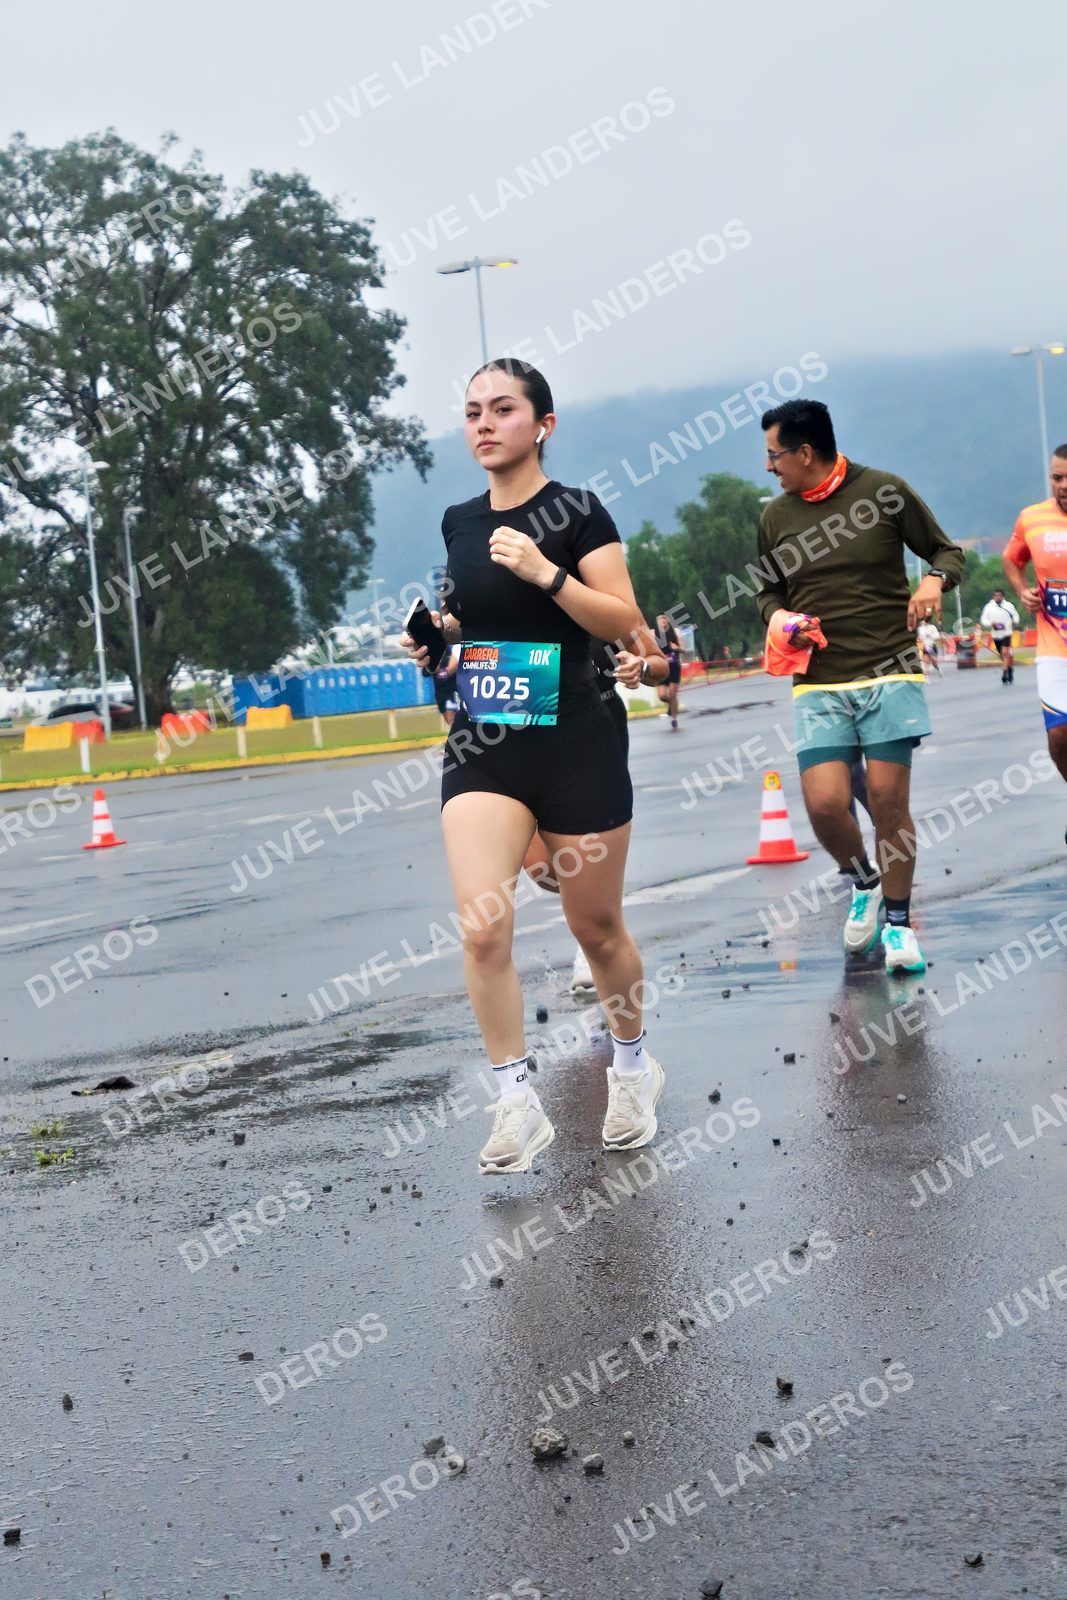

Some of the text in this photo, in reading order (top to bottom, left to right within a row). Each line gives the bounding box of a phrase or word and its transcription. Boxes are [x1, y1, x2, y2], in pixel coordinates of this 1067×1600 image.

[464, 648, 498, 661] CARRERA
[529, 649, 552, 666] 10K
[463, 661, 488, 670] OMNILIFE
[470, 675, 530, 700] 1025
